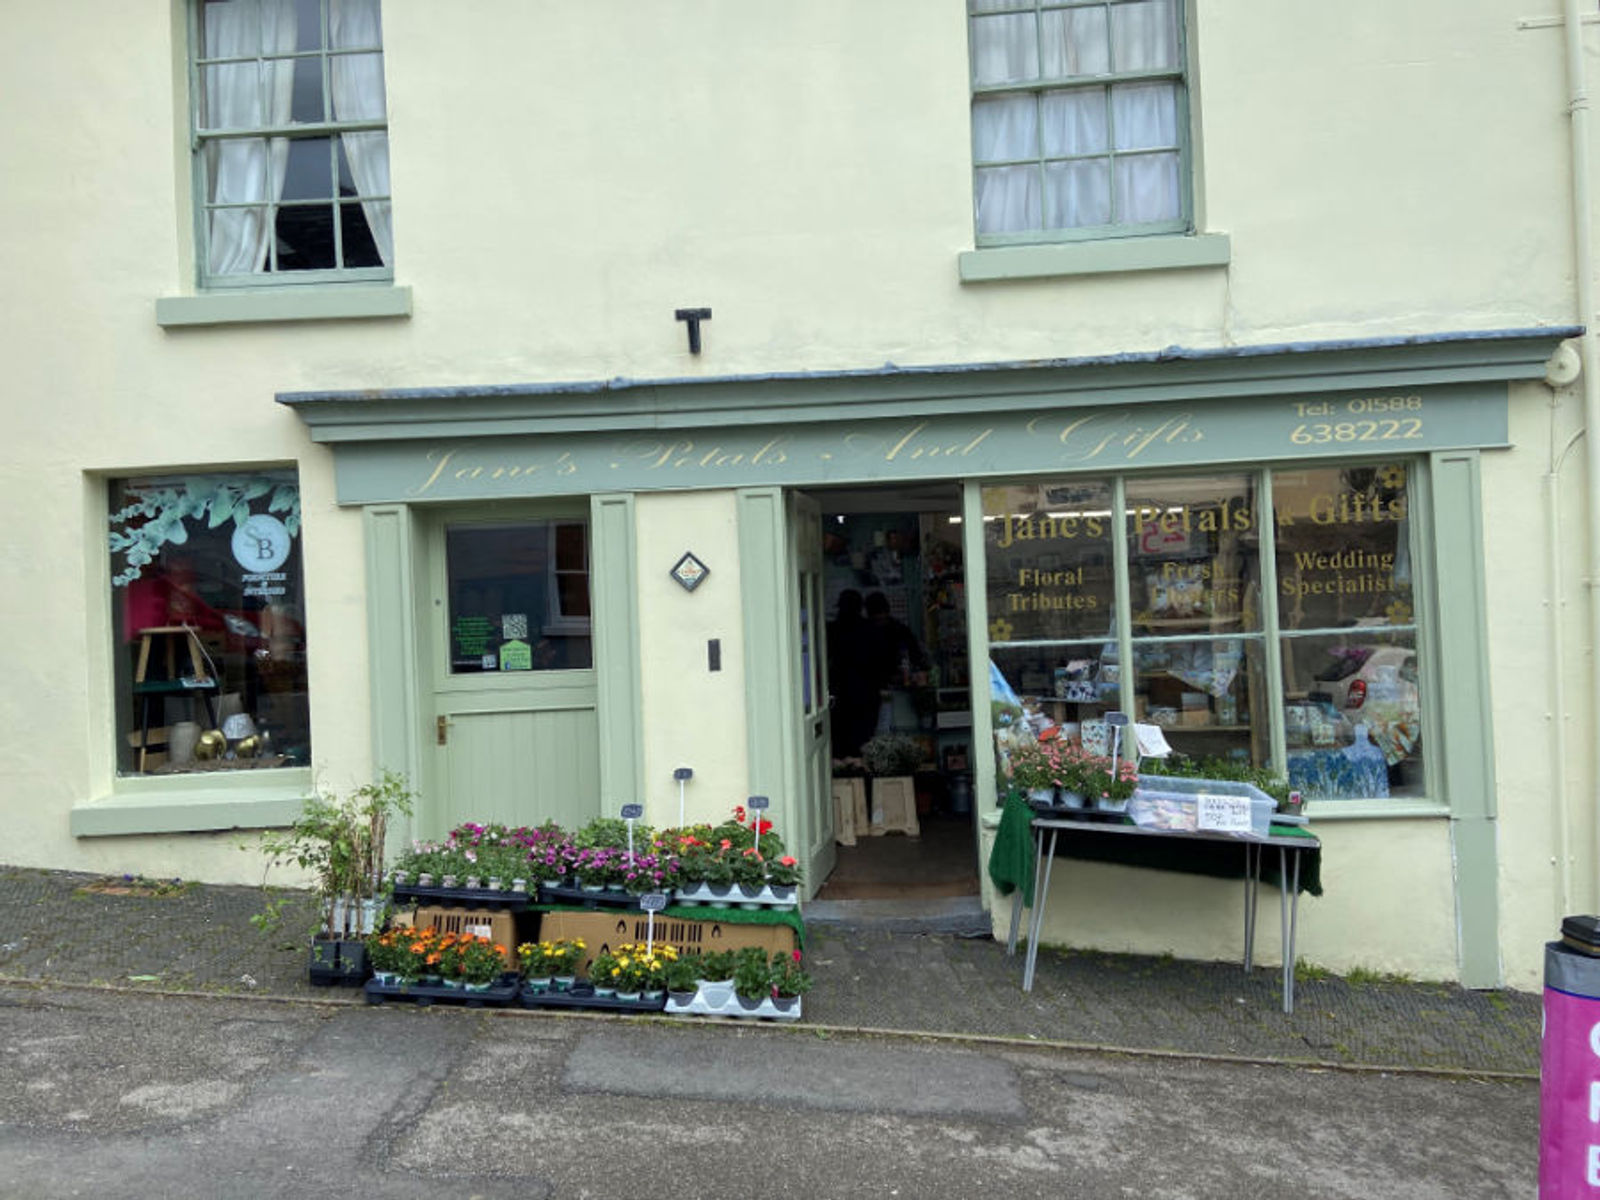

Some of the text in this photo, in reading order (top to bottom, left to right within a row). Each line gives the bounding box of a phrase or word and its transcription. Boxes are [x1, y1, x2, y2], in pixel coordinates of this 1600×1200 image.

[1292, 396, 1422, 417] Tel: 01588
[1290, 418, 1424, 445] 638222
[411, 449, 577, 495] Jane's
[616, 438, 790, 470] Petals
[1026, 412, 1206, 461] Gifts
[997, 510, 1104, 548] Jane's
[1134, 501, 1251, 535] Petals
[1310, 493, 1408, 526] Gifts
[1163, 557, 1225, 581] Fresh
[1295, 550, 1395, 571] Wedding
[1019, 567, 1083, 587] Floral
[1007, 592, 1098, 612] Tributes
